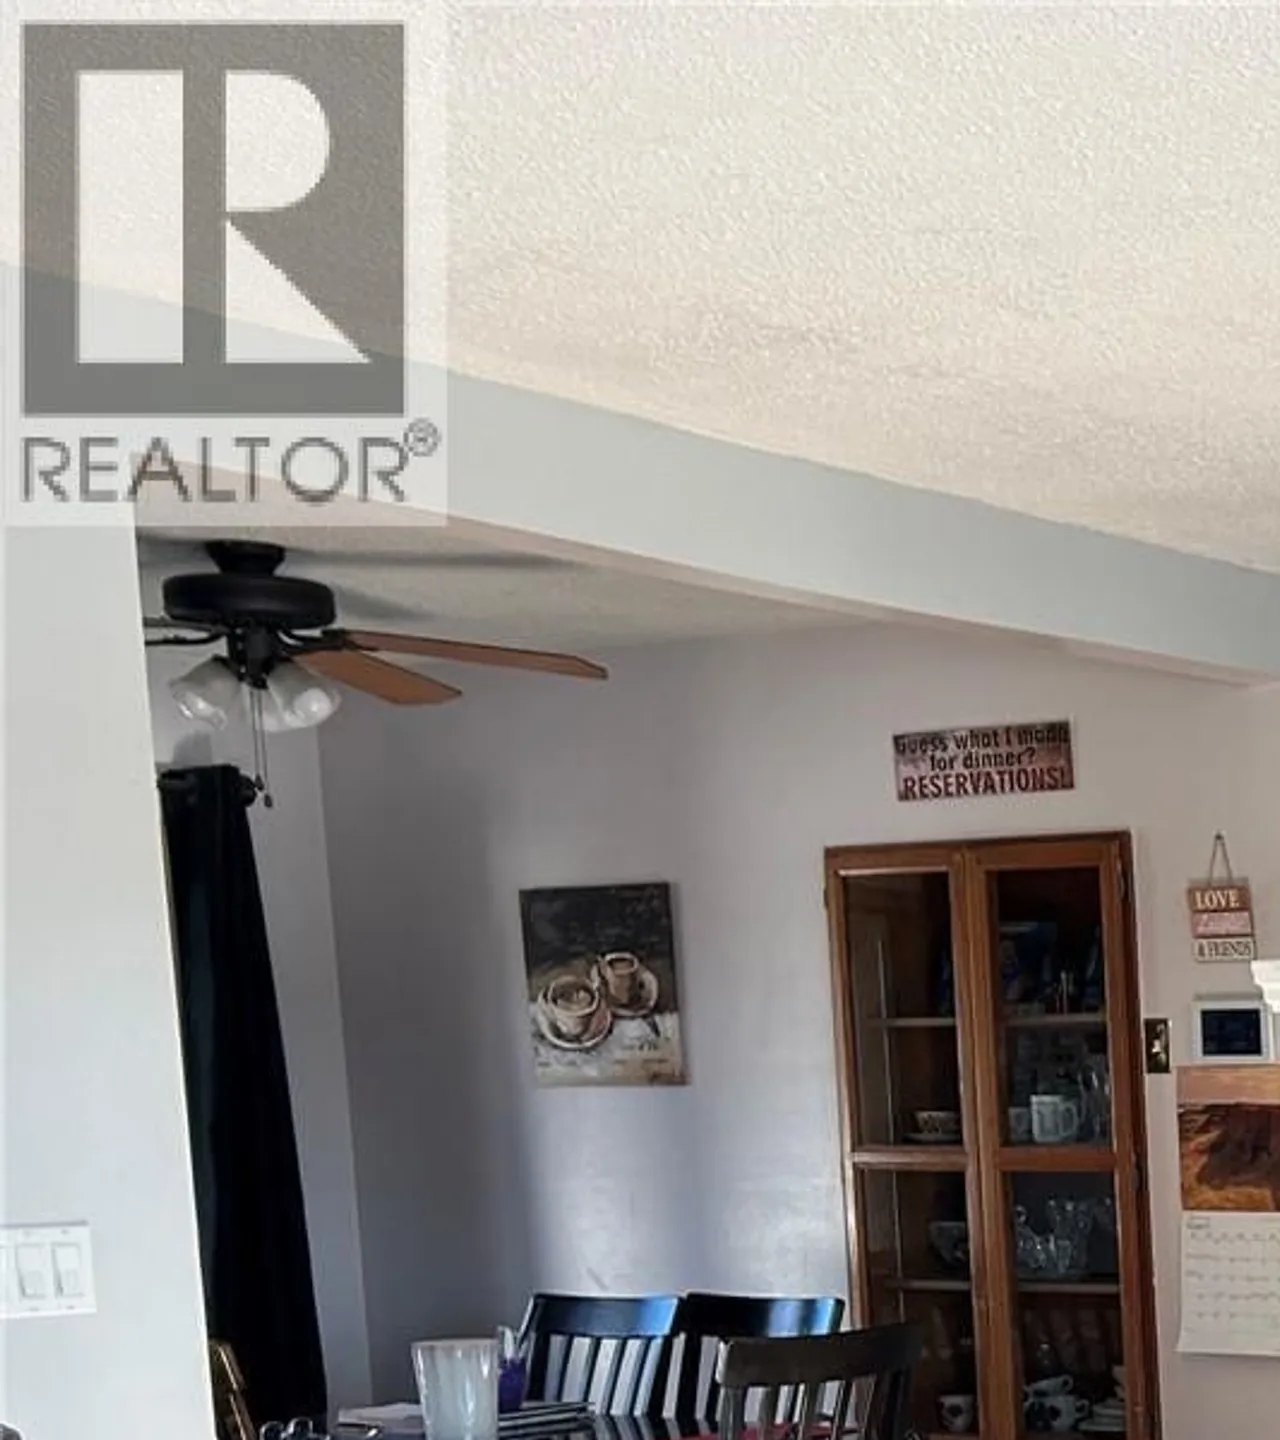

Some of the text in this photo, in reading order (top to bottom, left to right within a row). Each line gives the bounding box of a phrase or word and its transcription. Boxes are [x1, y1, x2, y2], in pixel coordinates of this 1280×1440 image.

[953, 729, 1000, 750] what
[930, 747, 1036, 771] for dinner?
[1195, 889, 1240, 910] LOVE
